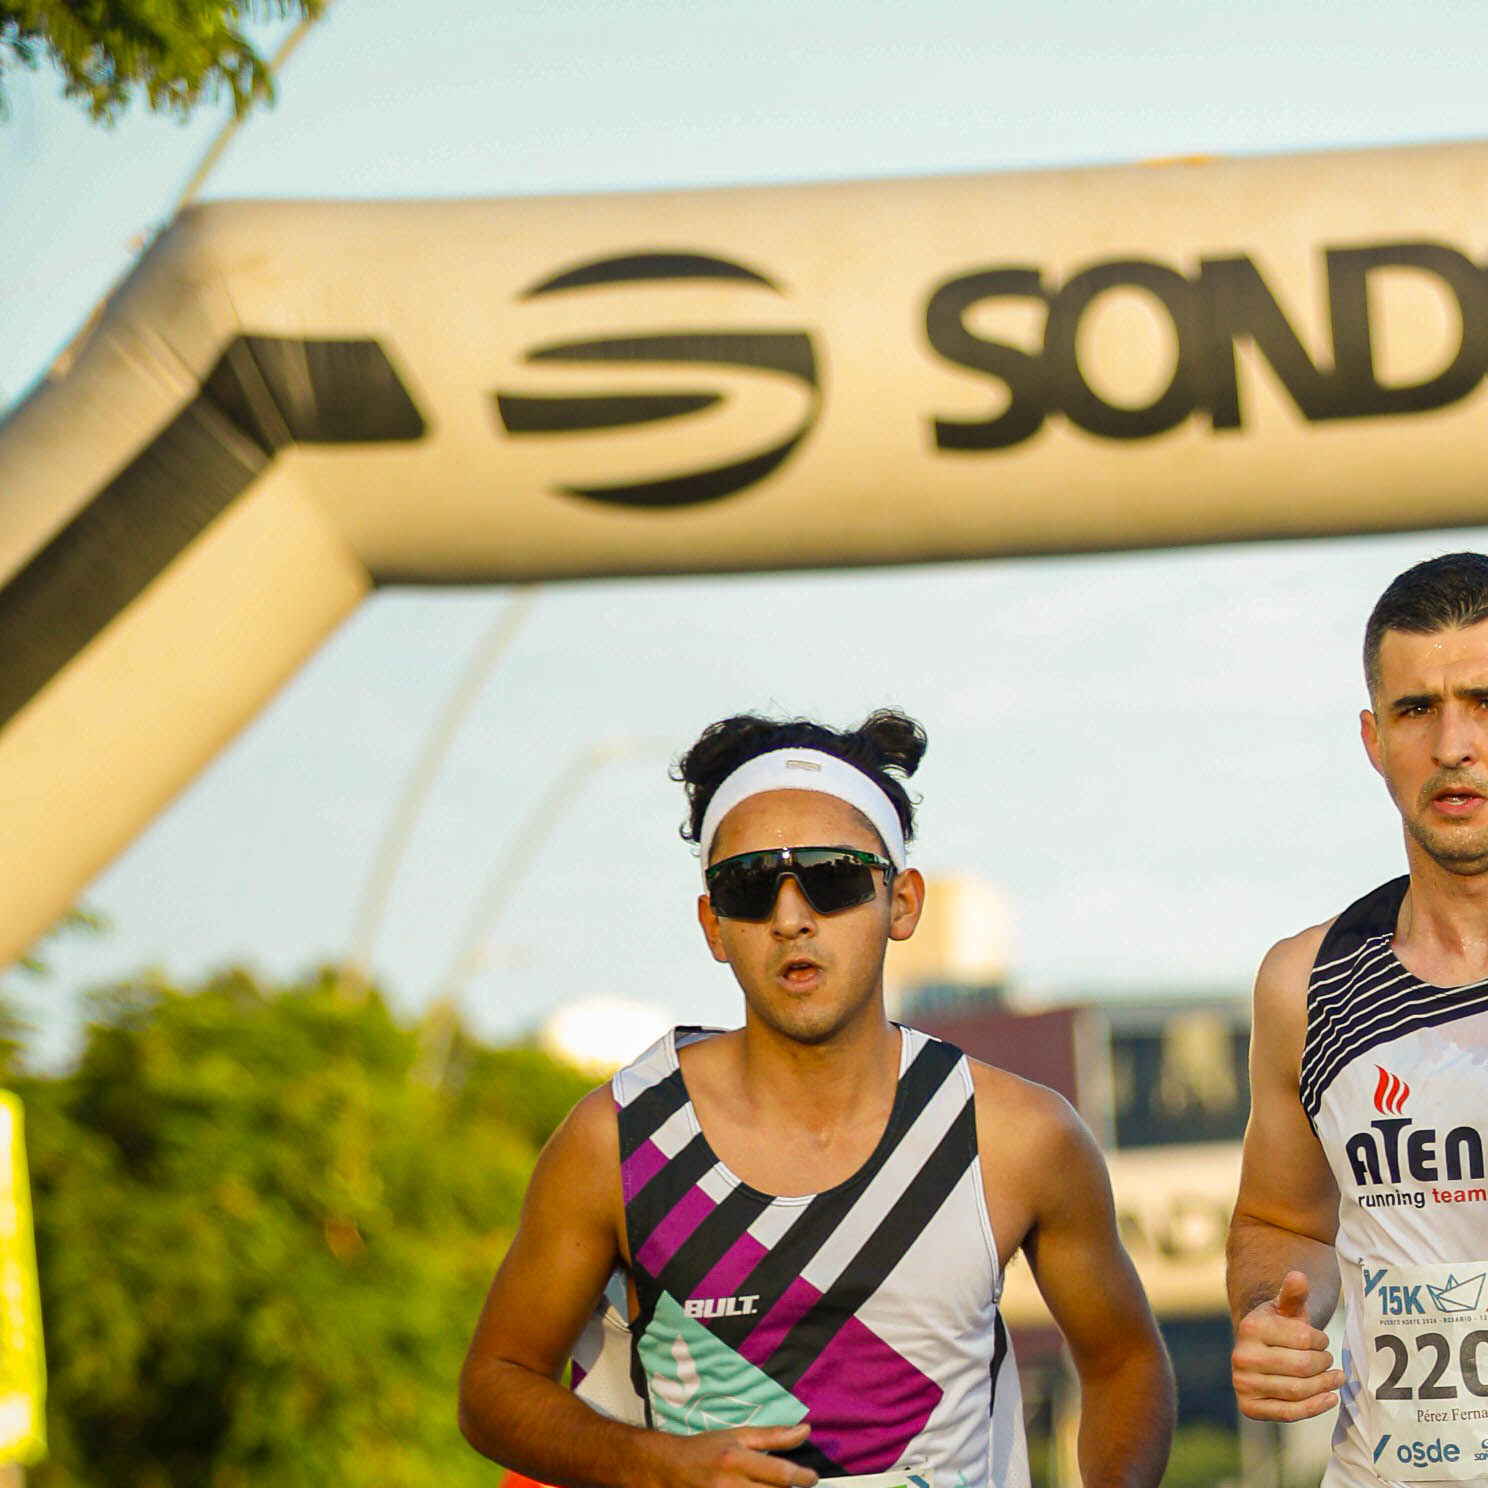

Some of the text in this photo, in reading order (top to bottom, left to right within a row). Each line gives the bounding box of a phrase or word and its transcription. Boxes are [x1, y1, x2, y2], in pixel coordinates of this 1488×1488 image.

[1358, 1187, 1487, 1208] running team
[1378, 1285, 1426, 1316] 15K
[1443, 1315, 1472, 1324] ROSARIO
[1417, 1409, 1448, 1423] Pérez
[1397, 1438, 1460, 1468] osde
